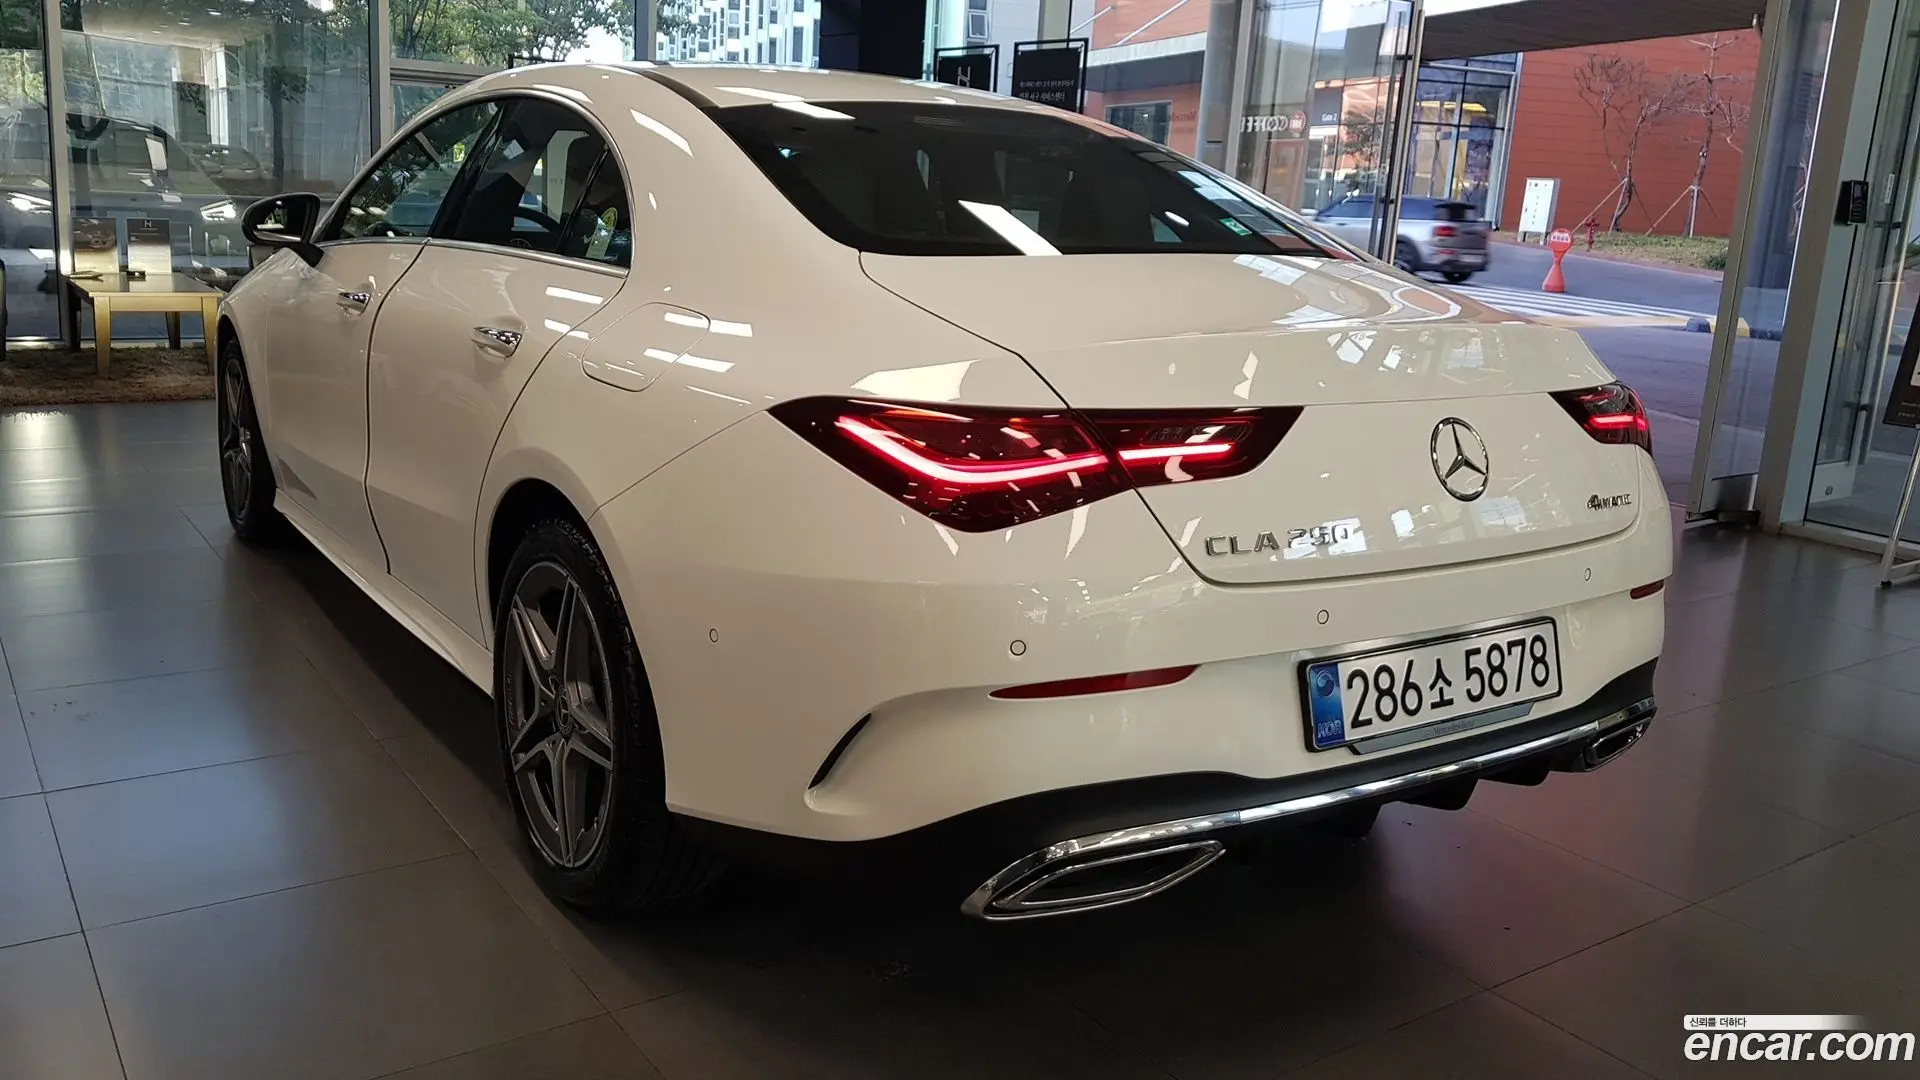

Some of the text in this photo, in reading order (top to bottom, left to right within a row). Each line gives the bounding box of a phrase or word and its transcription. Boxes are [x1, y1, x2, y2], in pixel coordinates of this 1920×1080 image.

[1204, 524, 1350, 556] CLA 250
[1347, 634, 1550, 729] 286소 5878
[1317, 719, 1342, 738] KOR
